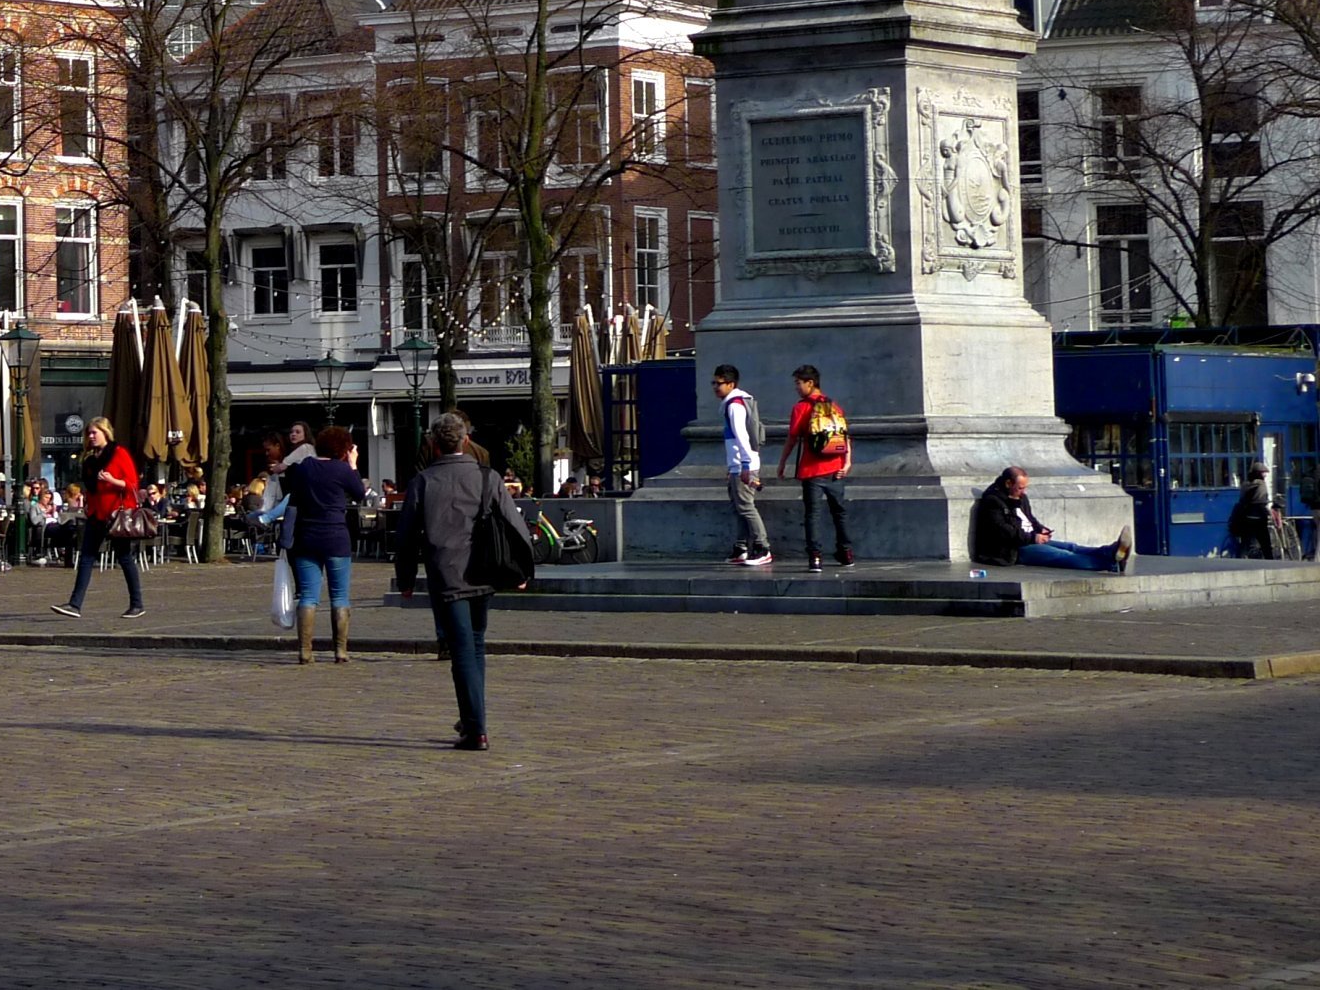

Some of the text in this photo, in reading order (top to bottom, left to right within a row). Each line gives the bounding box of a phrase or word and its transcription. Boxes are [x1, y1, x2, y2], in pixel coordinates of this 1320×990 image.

[819, 133, 853, 142] PRIMO
[456, 377, 474, 385] AND
[505, 370, 530, 385] BYBL
